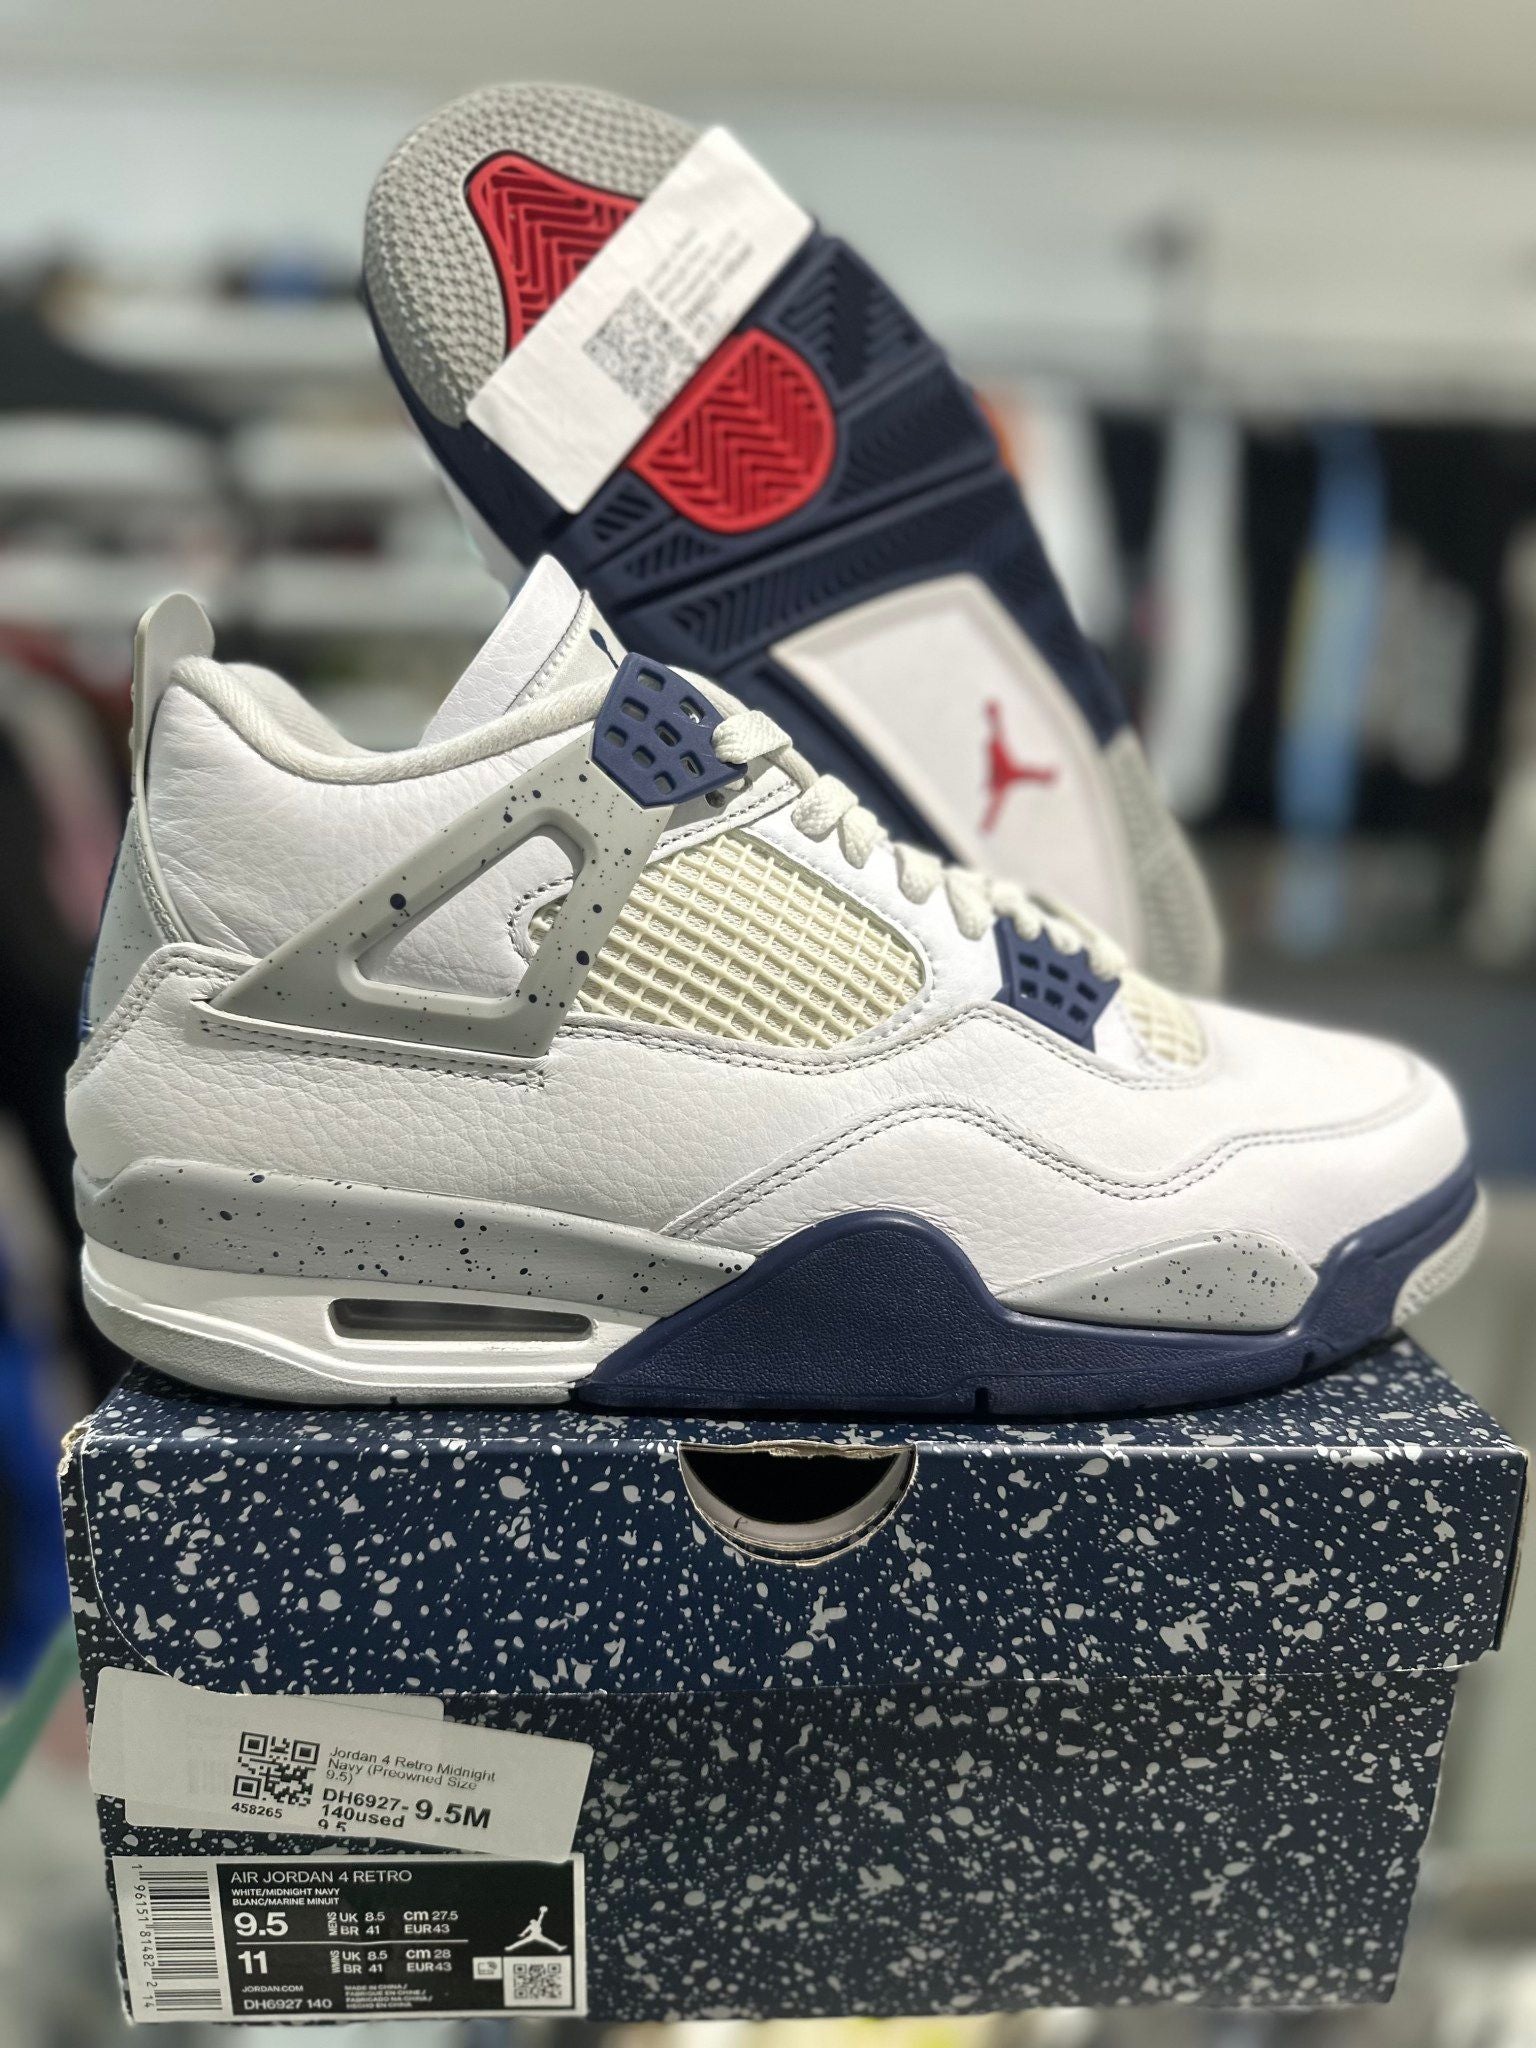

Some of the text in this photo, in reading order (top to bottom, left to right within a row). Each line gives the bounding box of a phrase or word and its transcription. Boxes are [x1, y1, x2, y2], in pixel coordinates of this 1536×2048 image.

[330, 1747, 496, 1782] Jordan 4 Retro Midnight
[326, 1769, 353, 1785] 9.5)
[328, 1758, 478, 1790] Navy (Preowned Size
[323, 1788, 409, 1811] DH6927-
[231, 1802, 283, 1819] 458265
[322, 1804, 405, 1828] 140used
[415, 1798, 491, 1829] 9.5M
[231, 1870, 412, 1883] AIR JORDAN 4 RETRO
[231, 1888, 340, 1896] WHITE/MIDNIGHT NAVY
[134, 1885, 149, 1921] 96151
[232, 1897, 339, 1906] BLANC/MARINE MINUIT
[327, 1911, 338, 1936] MENS
[339, 1911, 385, 1922] UK 8.5
[403, 1910, 458, 1921] cm 27.5
[234, 1912, 289, 1936] 9.5
[341, 1925, 380, 1935] BR 41
[140, 1931, 155, 1967] 81482
[342, 1950, 388, 1961] UK 8.5
[405, 1949, 451, 1960] cm 28
[238, 1950, 268, 1974] 11
[343, 1963, 383, 1974] BR 41
[242, 1985, 304, 1993] JORDAN.COM
[244, 1999, 333, 2010] DH6927 140
